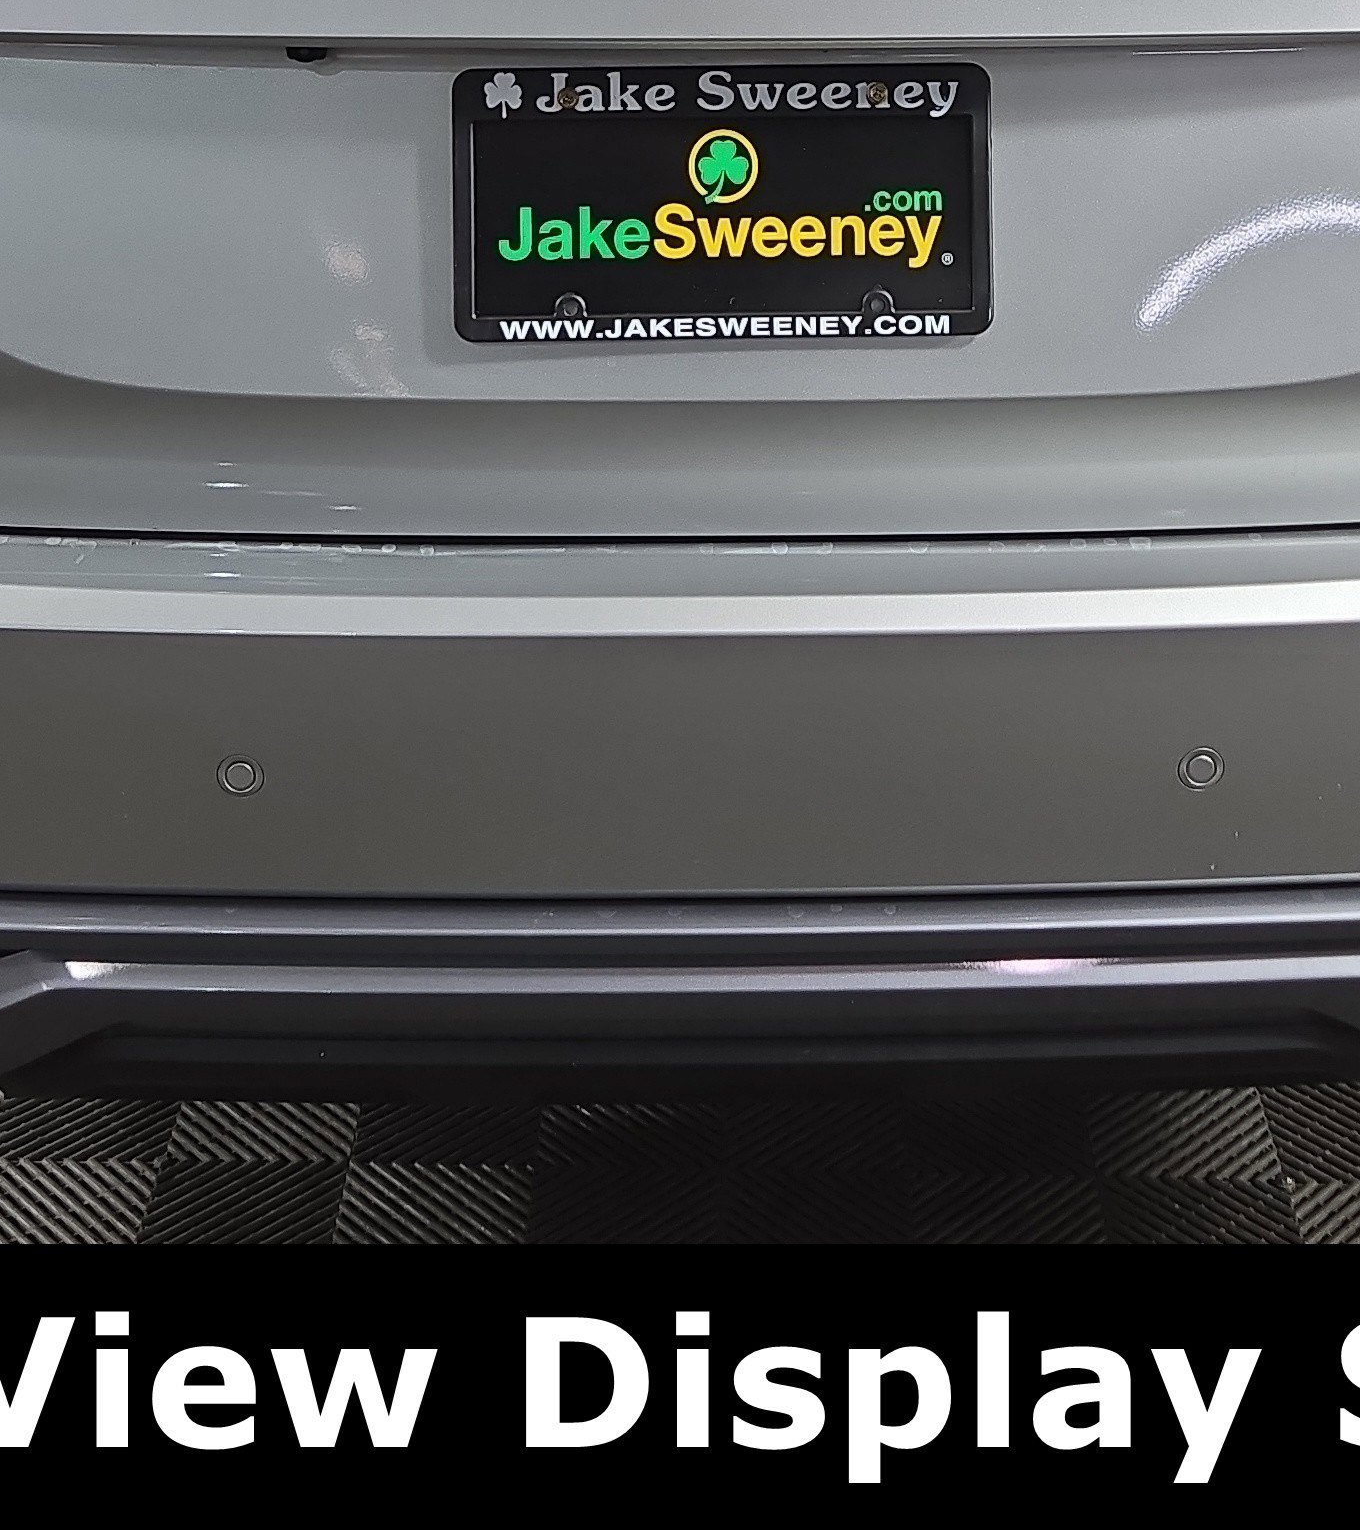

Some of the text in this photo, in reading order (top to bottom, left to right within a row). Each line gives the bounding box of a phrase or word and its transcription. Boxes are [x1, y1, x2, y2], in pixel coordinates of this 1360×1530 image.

[536, 70, 960, 118] Jake Sweeney
[499, 313, 952, 341] WWW.JAKESWEENEY.COM
